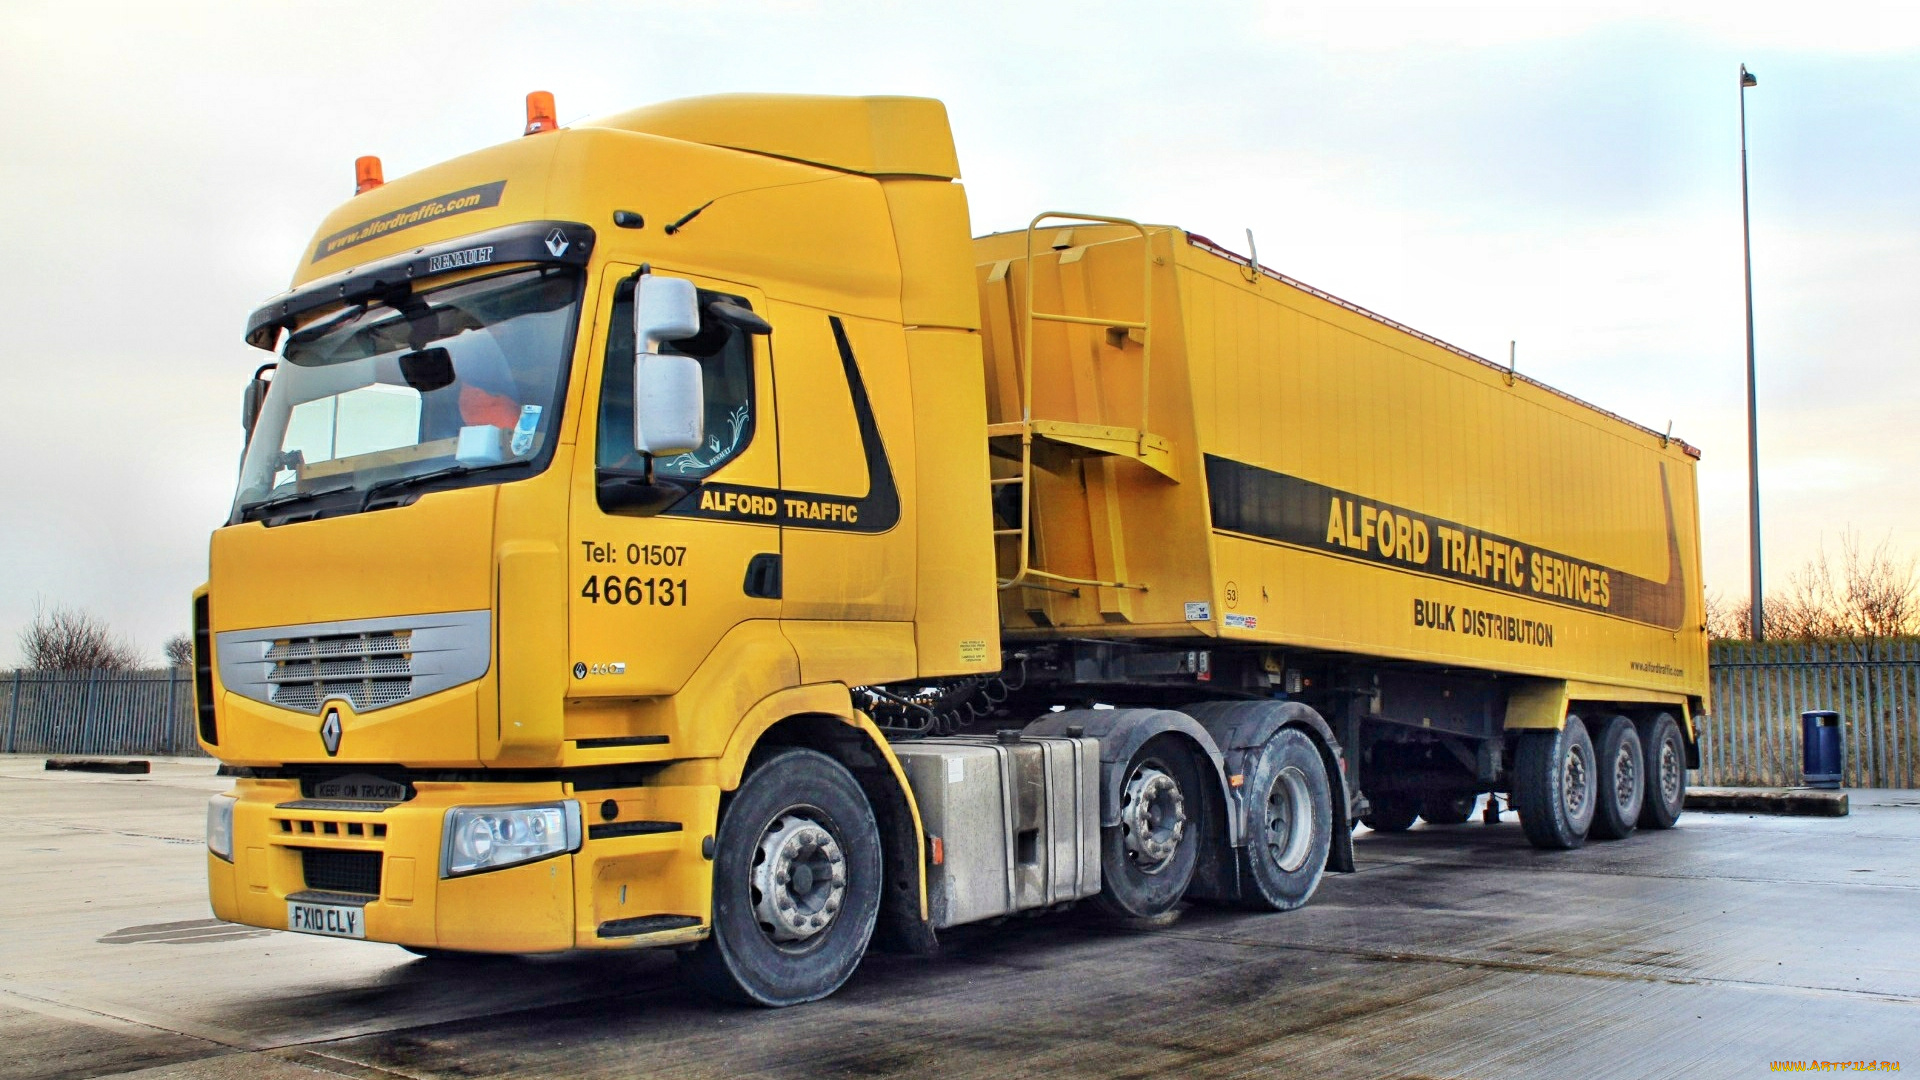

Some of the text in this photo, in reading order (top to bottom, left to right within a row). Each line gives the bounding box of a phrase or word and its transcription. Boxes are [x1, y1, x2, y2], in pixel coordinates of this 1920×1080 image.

[327, 194, 481, 251] www.alfordtraffic.com
[429, 246, 493, 272] RENAULT
[709, 446, 732, 466] RENAULT
[700, 490, 858, 523] ALFORD TRAFFIC
[581, 540, 687, 567] Tel: 01507
[1326, 497, 1610, 608] ALFORD TRAFFIC SERVICES
[581, 575, 687, 606] 466131
[1226, 589, 1236, 601] 53
[1413, 598, 1553, 648] BULK DISTRIBUTION
[590, 663, 616, 675] 460
[1630, 661, 1684, 677] www.alfordtraffic.com
[320, 785, 341, 797] KEEP
[344, 785, 357, 797] ON
[327, 909, 355, 934] CLV
